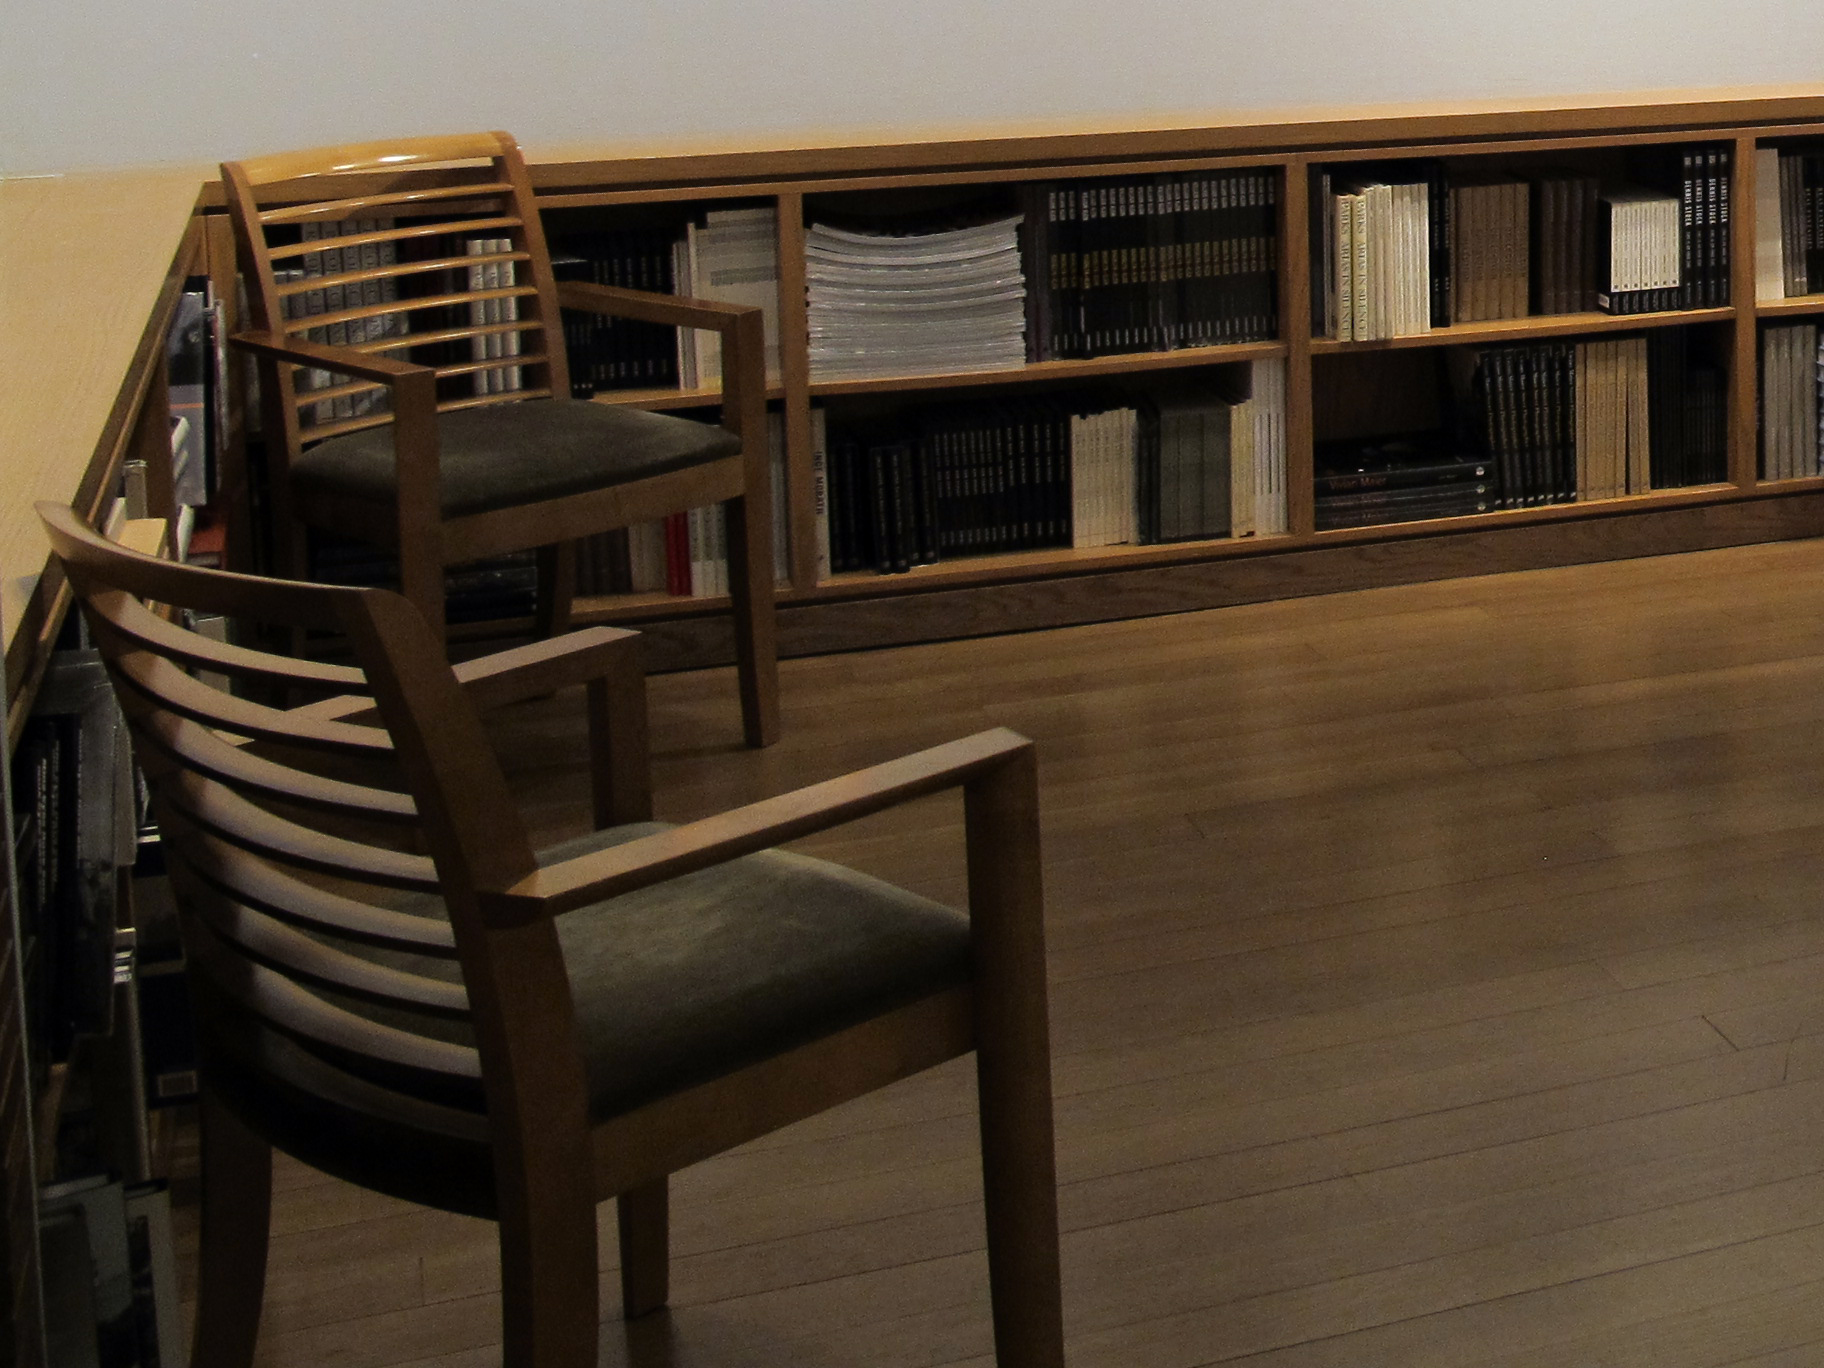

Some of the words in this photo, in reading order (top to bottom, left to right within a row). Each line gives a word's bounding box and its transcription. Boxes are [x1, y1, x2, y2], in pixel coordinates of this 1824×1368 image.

[1720, 177, 1728, 200] DENNIS
[1342, 241, 1351, 272] ARIAS
[1357, 241, 1367, 271] ARIAS
[1342, 275, 1351, 286] IN
[1358, 274, 1367, 285] IN
[1342, 289, 1351, 332] SILENCE
[1358, 289, 1367, 332] SILENCE
